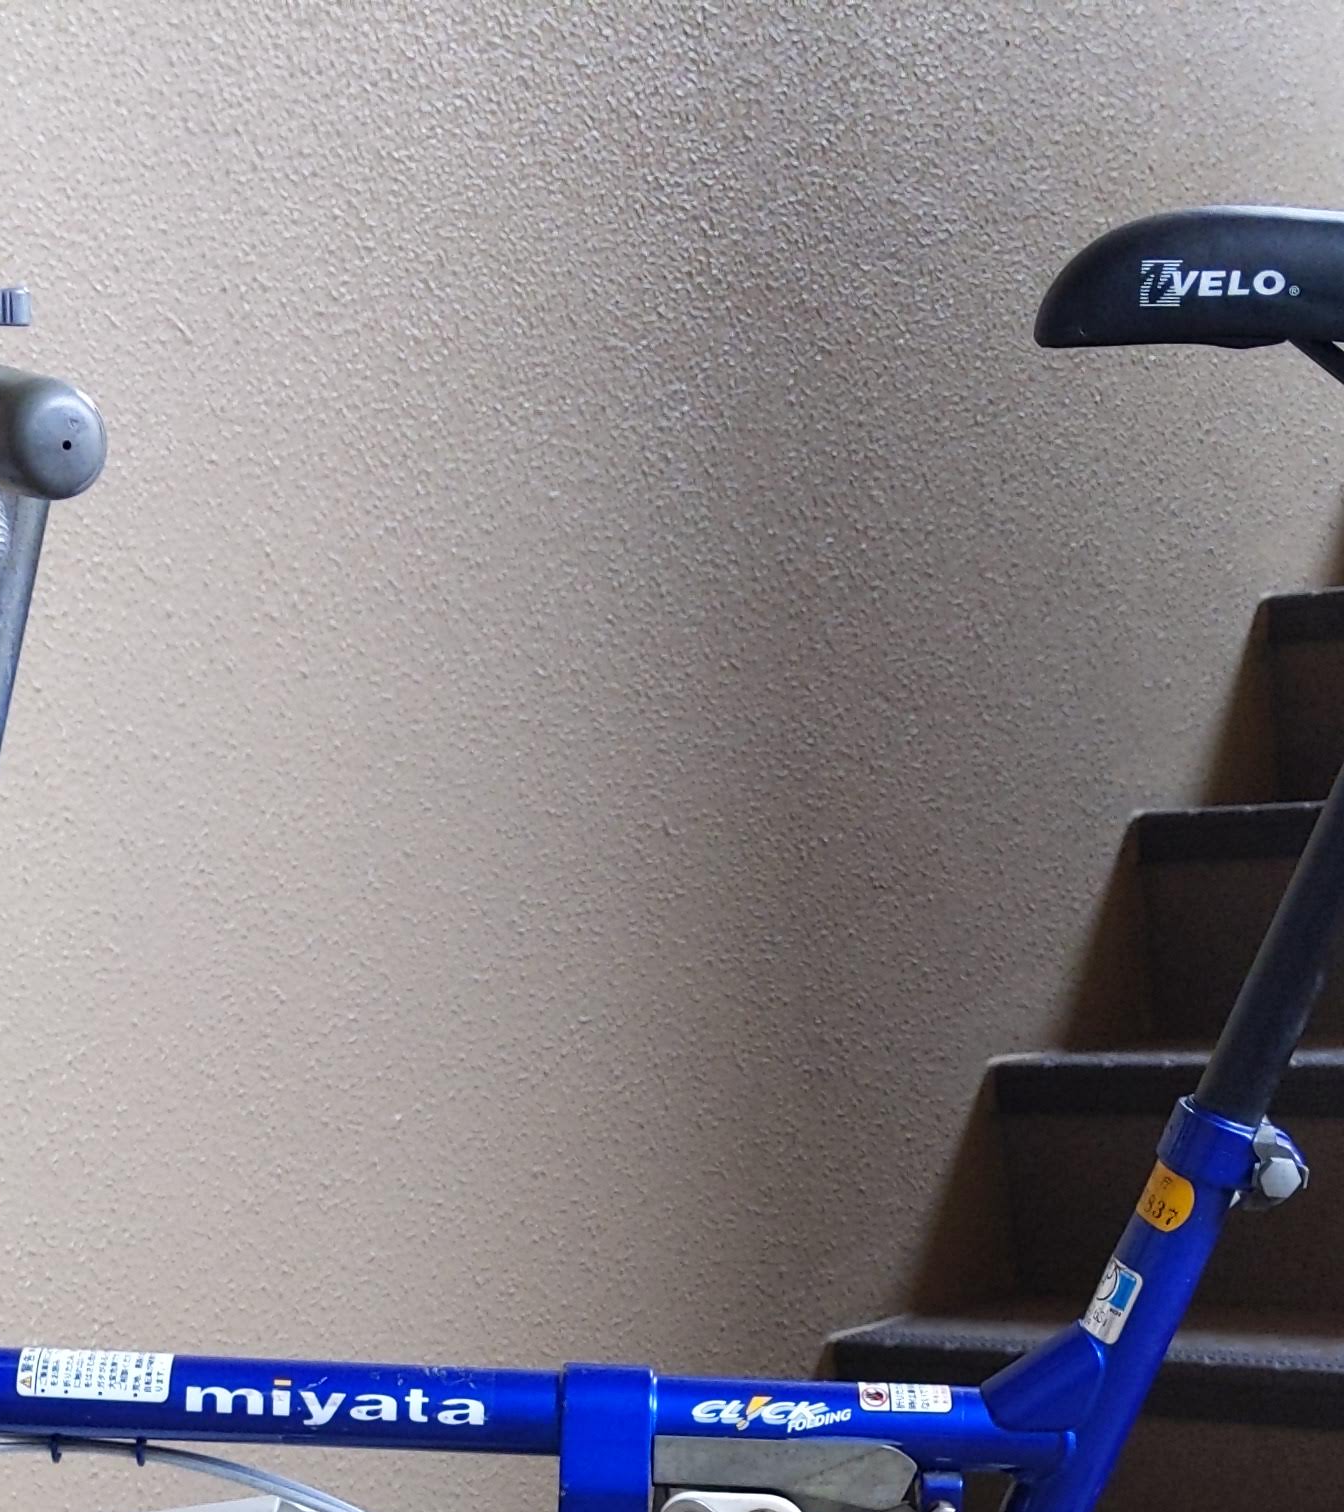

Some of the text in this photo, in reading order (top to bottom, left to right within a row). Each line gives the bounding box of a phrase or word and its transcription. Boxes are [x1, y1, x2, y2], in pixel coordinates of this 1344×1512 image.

[1170, 269, 1286, 297] VELO
[185, 1379, 485, 1426] miyata
[787, 1408, 852, 1433] FOLDING
